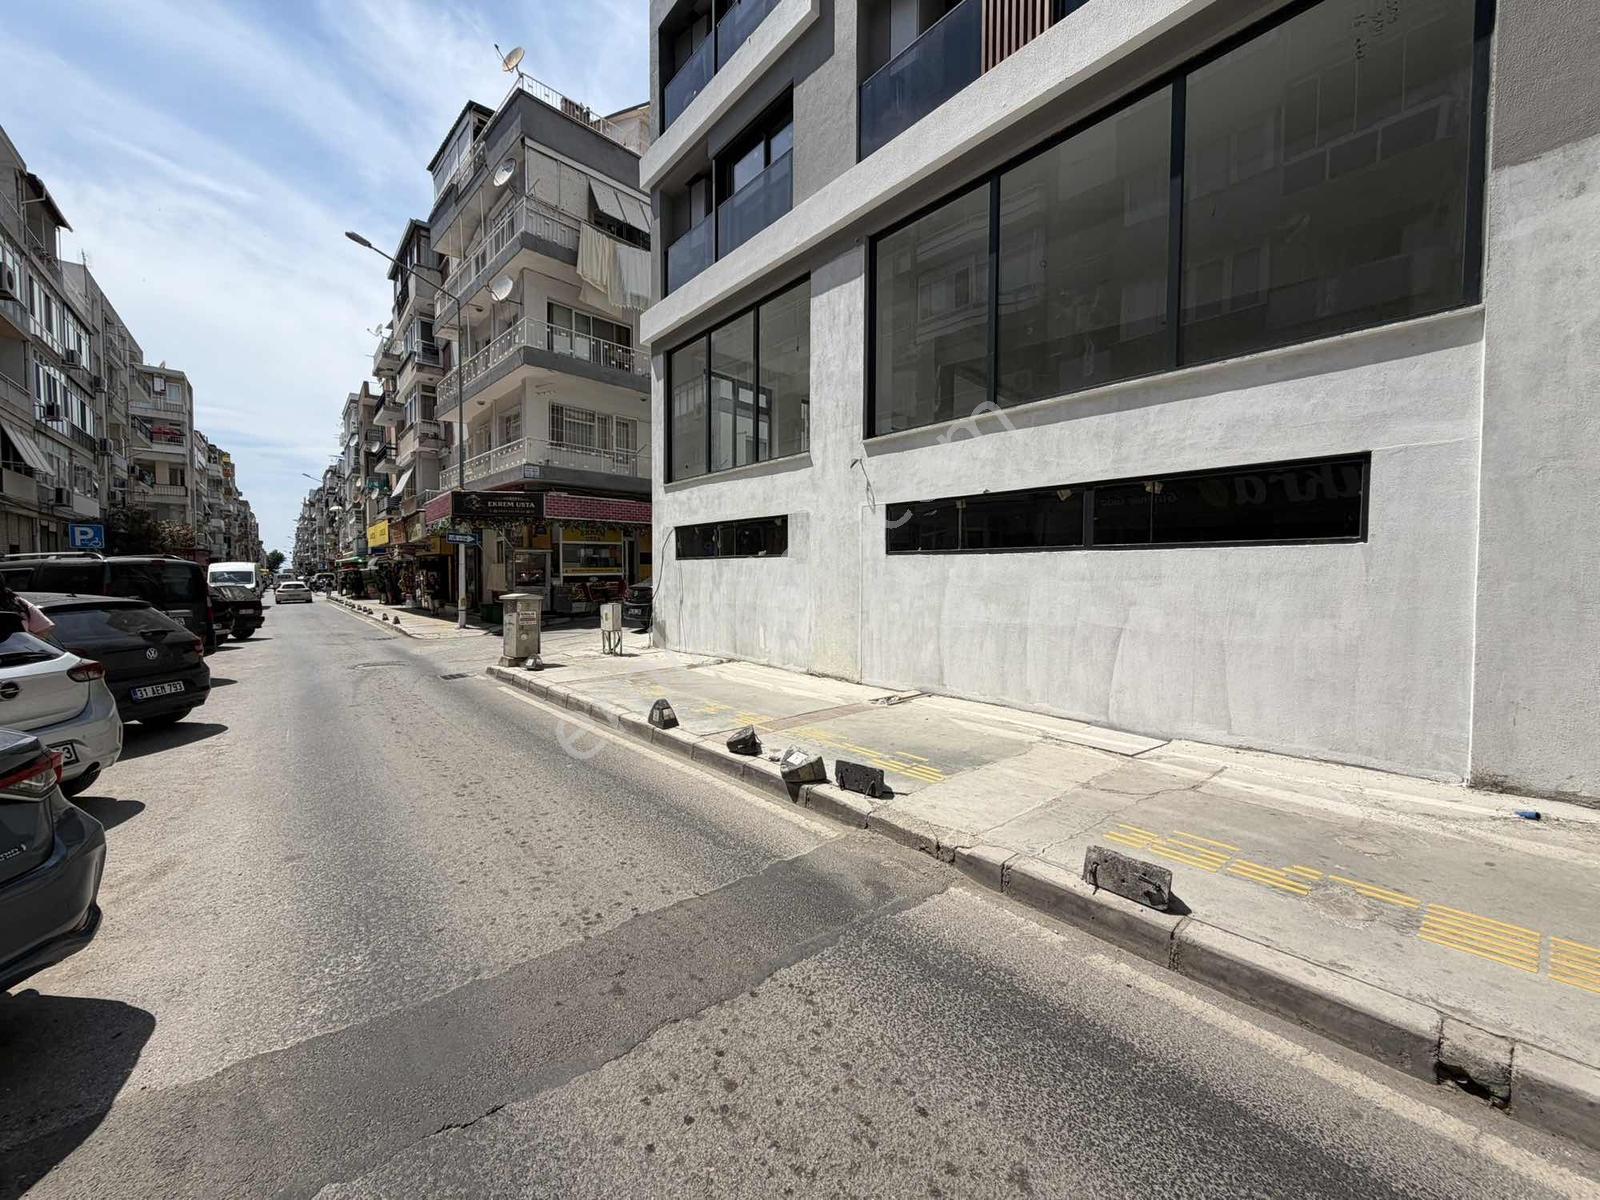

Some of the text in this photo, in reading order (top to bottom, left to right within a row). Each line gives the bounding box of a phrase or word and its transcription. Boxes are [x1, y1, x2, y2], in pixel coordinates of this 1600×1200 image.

[75, 526, 94, 546] P
[137, 688, 149, 698] 31
[167, 682, 183, 693] 793
